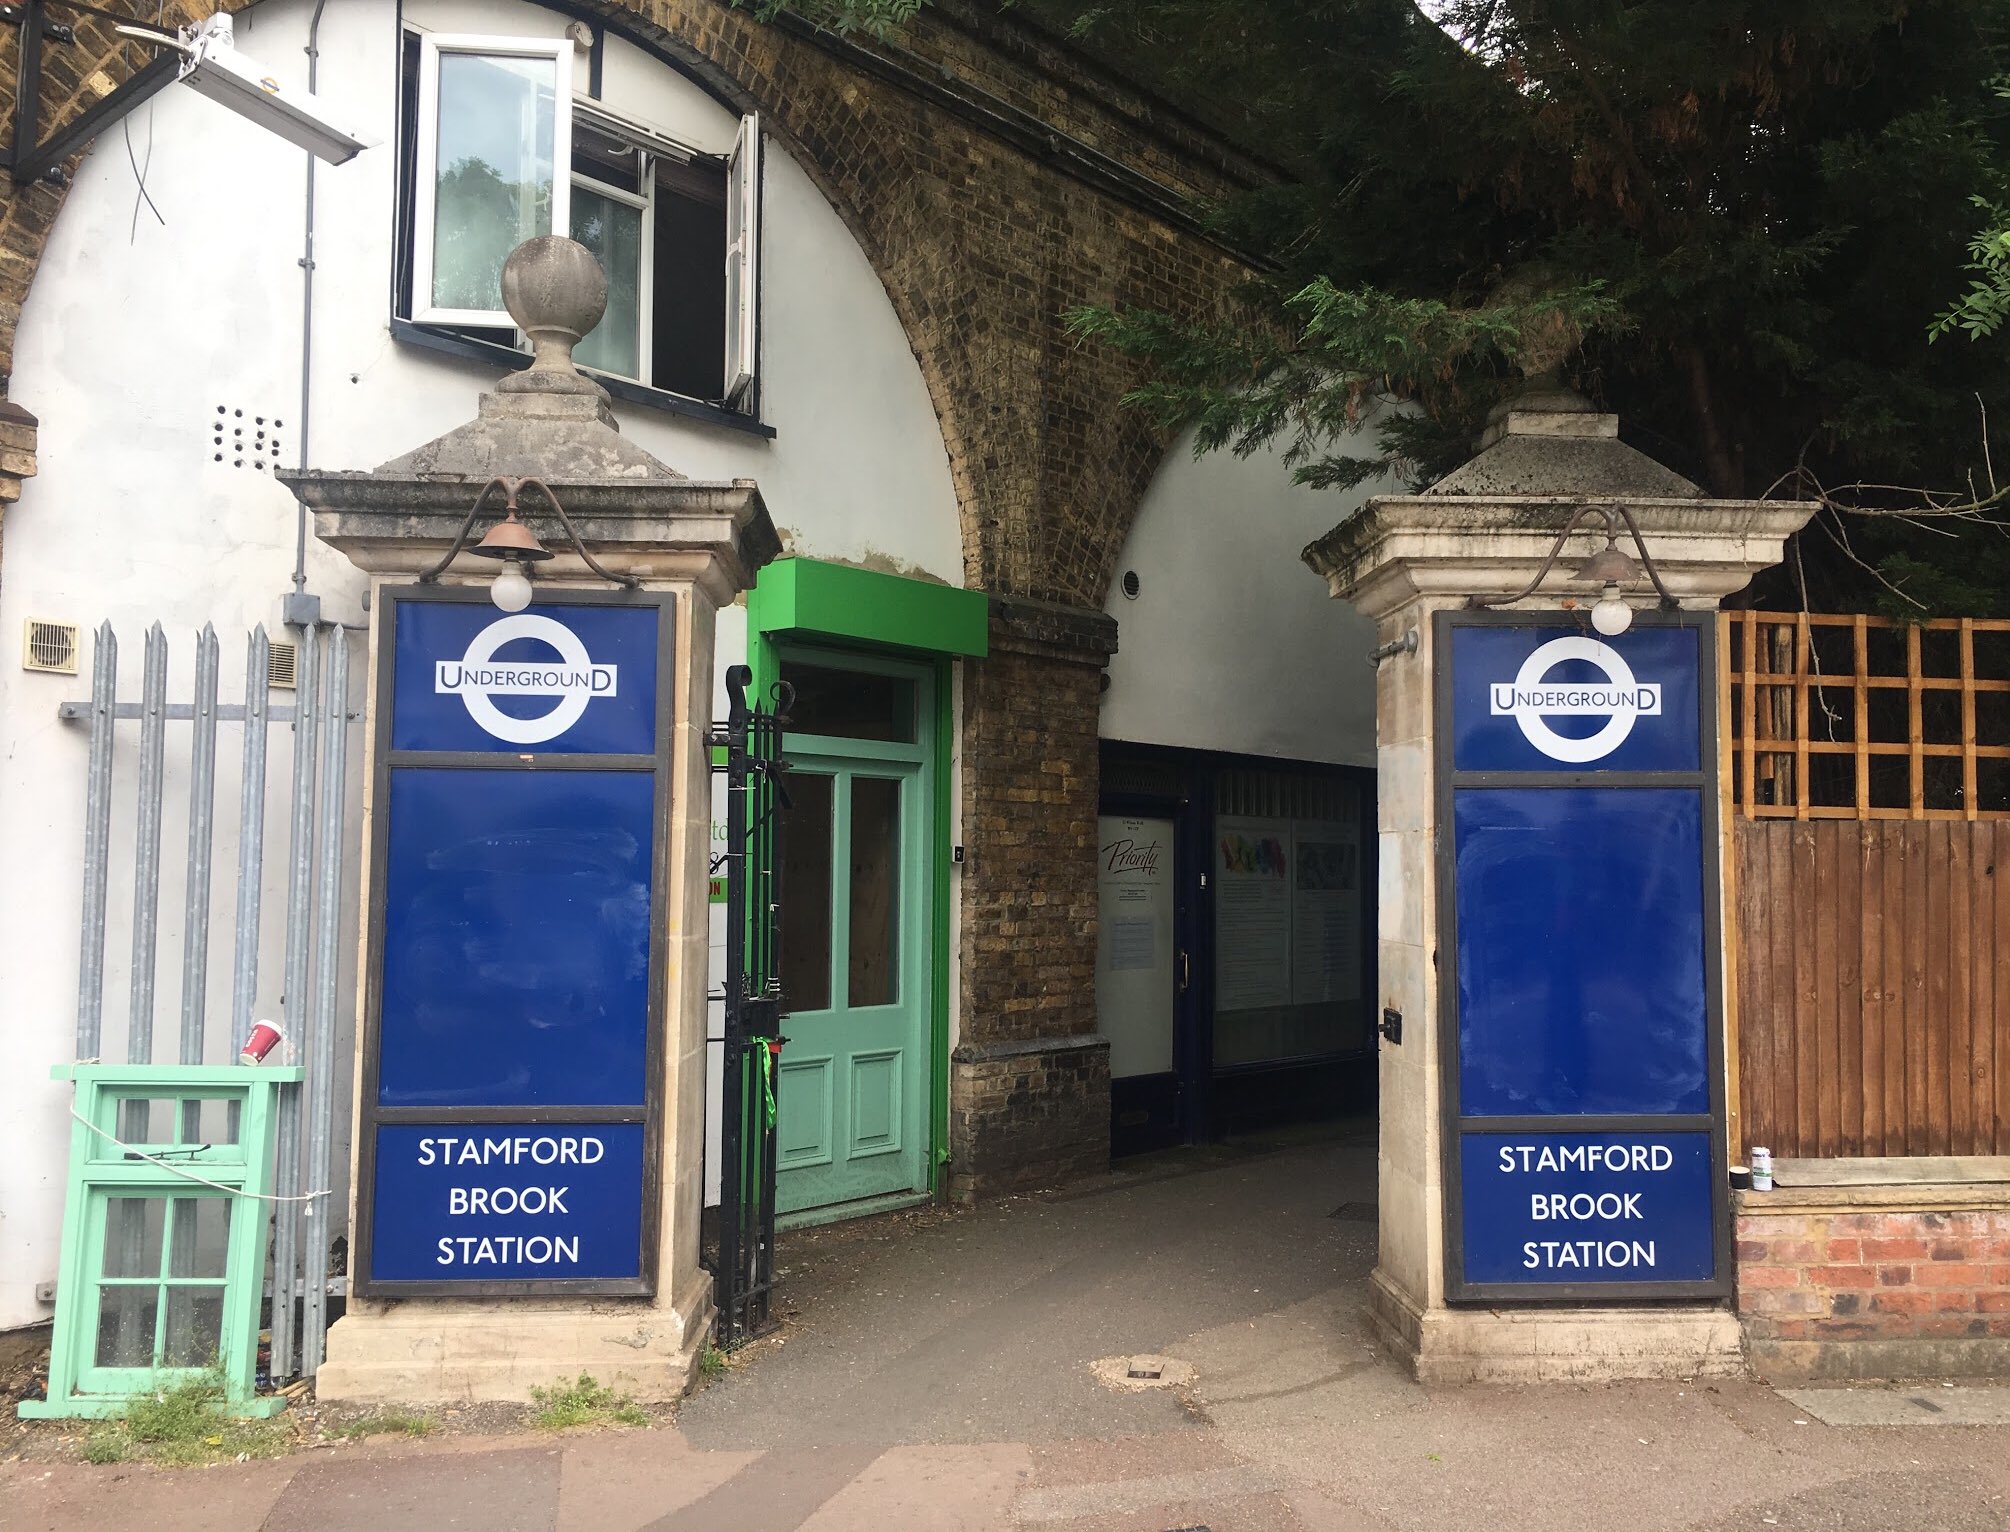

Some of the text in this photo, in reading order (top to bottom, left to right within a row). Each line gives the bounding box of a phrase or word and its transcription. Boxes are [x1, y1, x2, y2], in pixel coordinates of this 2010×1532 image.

[440, 665, 612, 692] UNDERGROUND
[1495, 687, 1656, 711] UNDERGROUND
[1102, 839, 1162, 876] Priority
[417, 1137, 604, 1166] STAMFORD
[1499, 1145, 1673, 1173] STAMFORD
[449, 1186, 569, 1215] BROOK
[1531, 1192, 1644, 1220] BROOK
[436, 1236, 579, 1265] STATION
[1522, 1240, 1656, 1269] STATION
